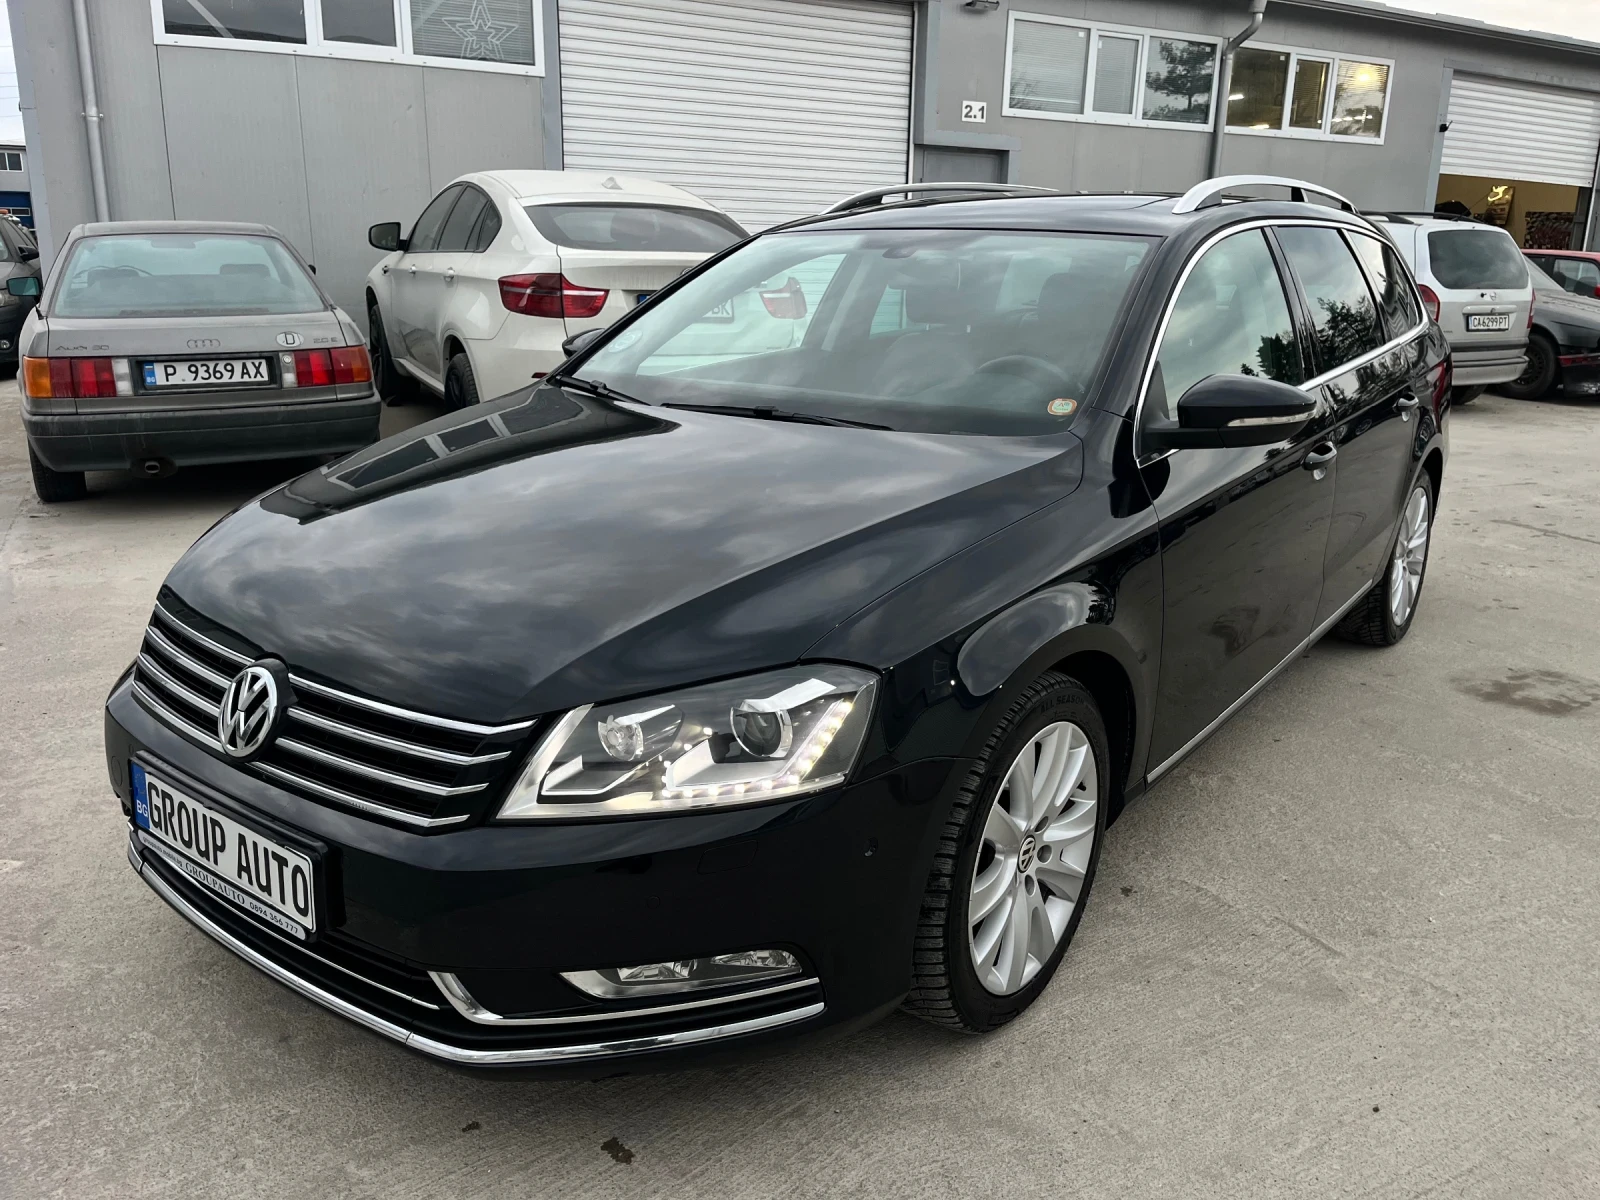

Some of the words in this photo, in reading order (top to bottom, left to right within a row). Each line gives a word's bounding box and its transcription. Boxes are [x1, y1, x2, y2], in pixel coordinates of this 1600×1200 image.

[964, 104, 985, 119] 2.1
[163, 364, 177, 383] P
[187, 362, 235, 381] 9369
[240, 361, 265, 379] AX
[136, 800, 149, 818] BG
[147, 781, 226, 866] GROUP
[237, 832, 309, 918] AUTO
[185, 862, 246, 906] GROUPAUTO
[249, 901, 268, 917] 0894
[269, 913, 284, 926] 356
[284, 920, 299, 934] 777
